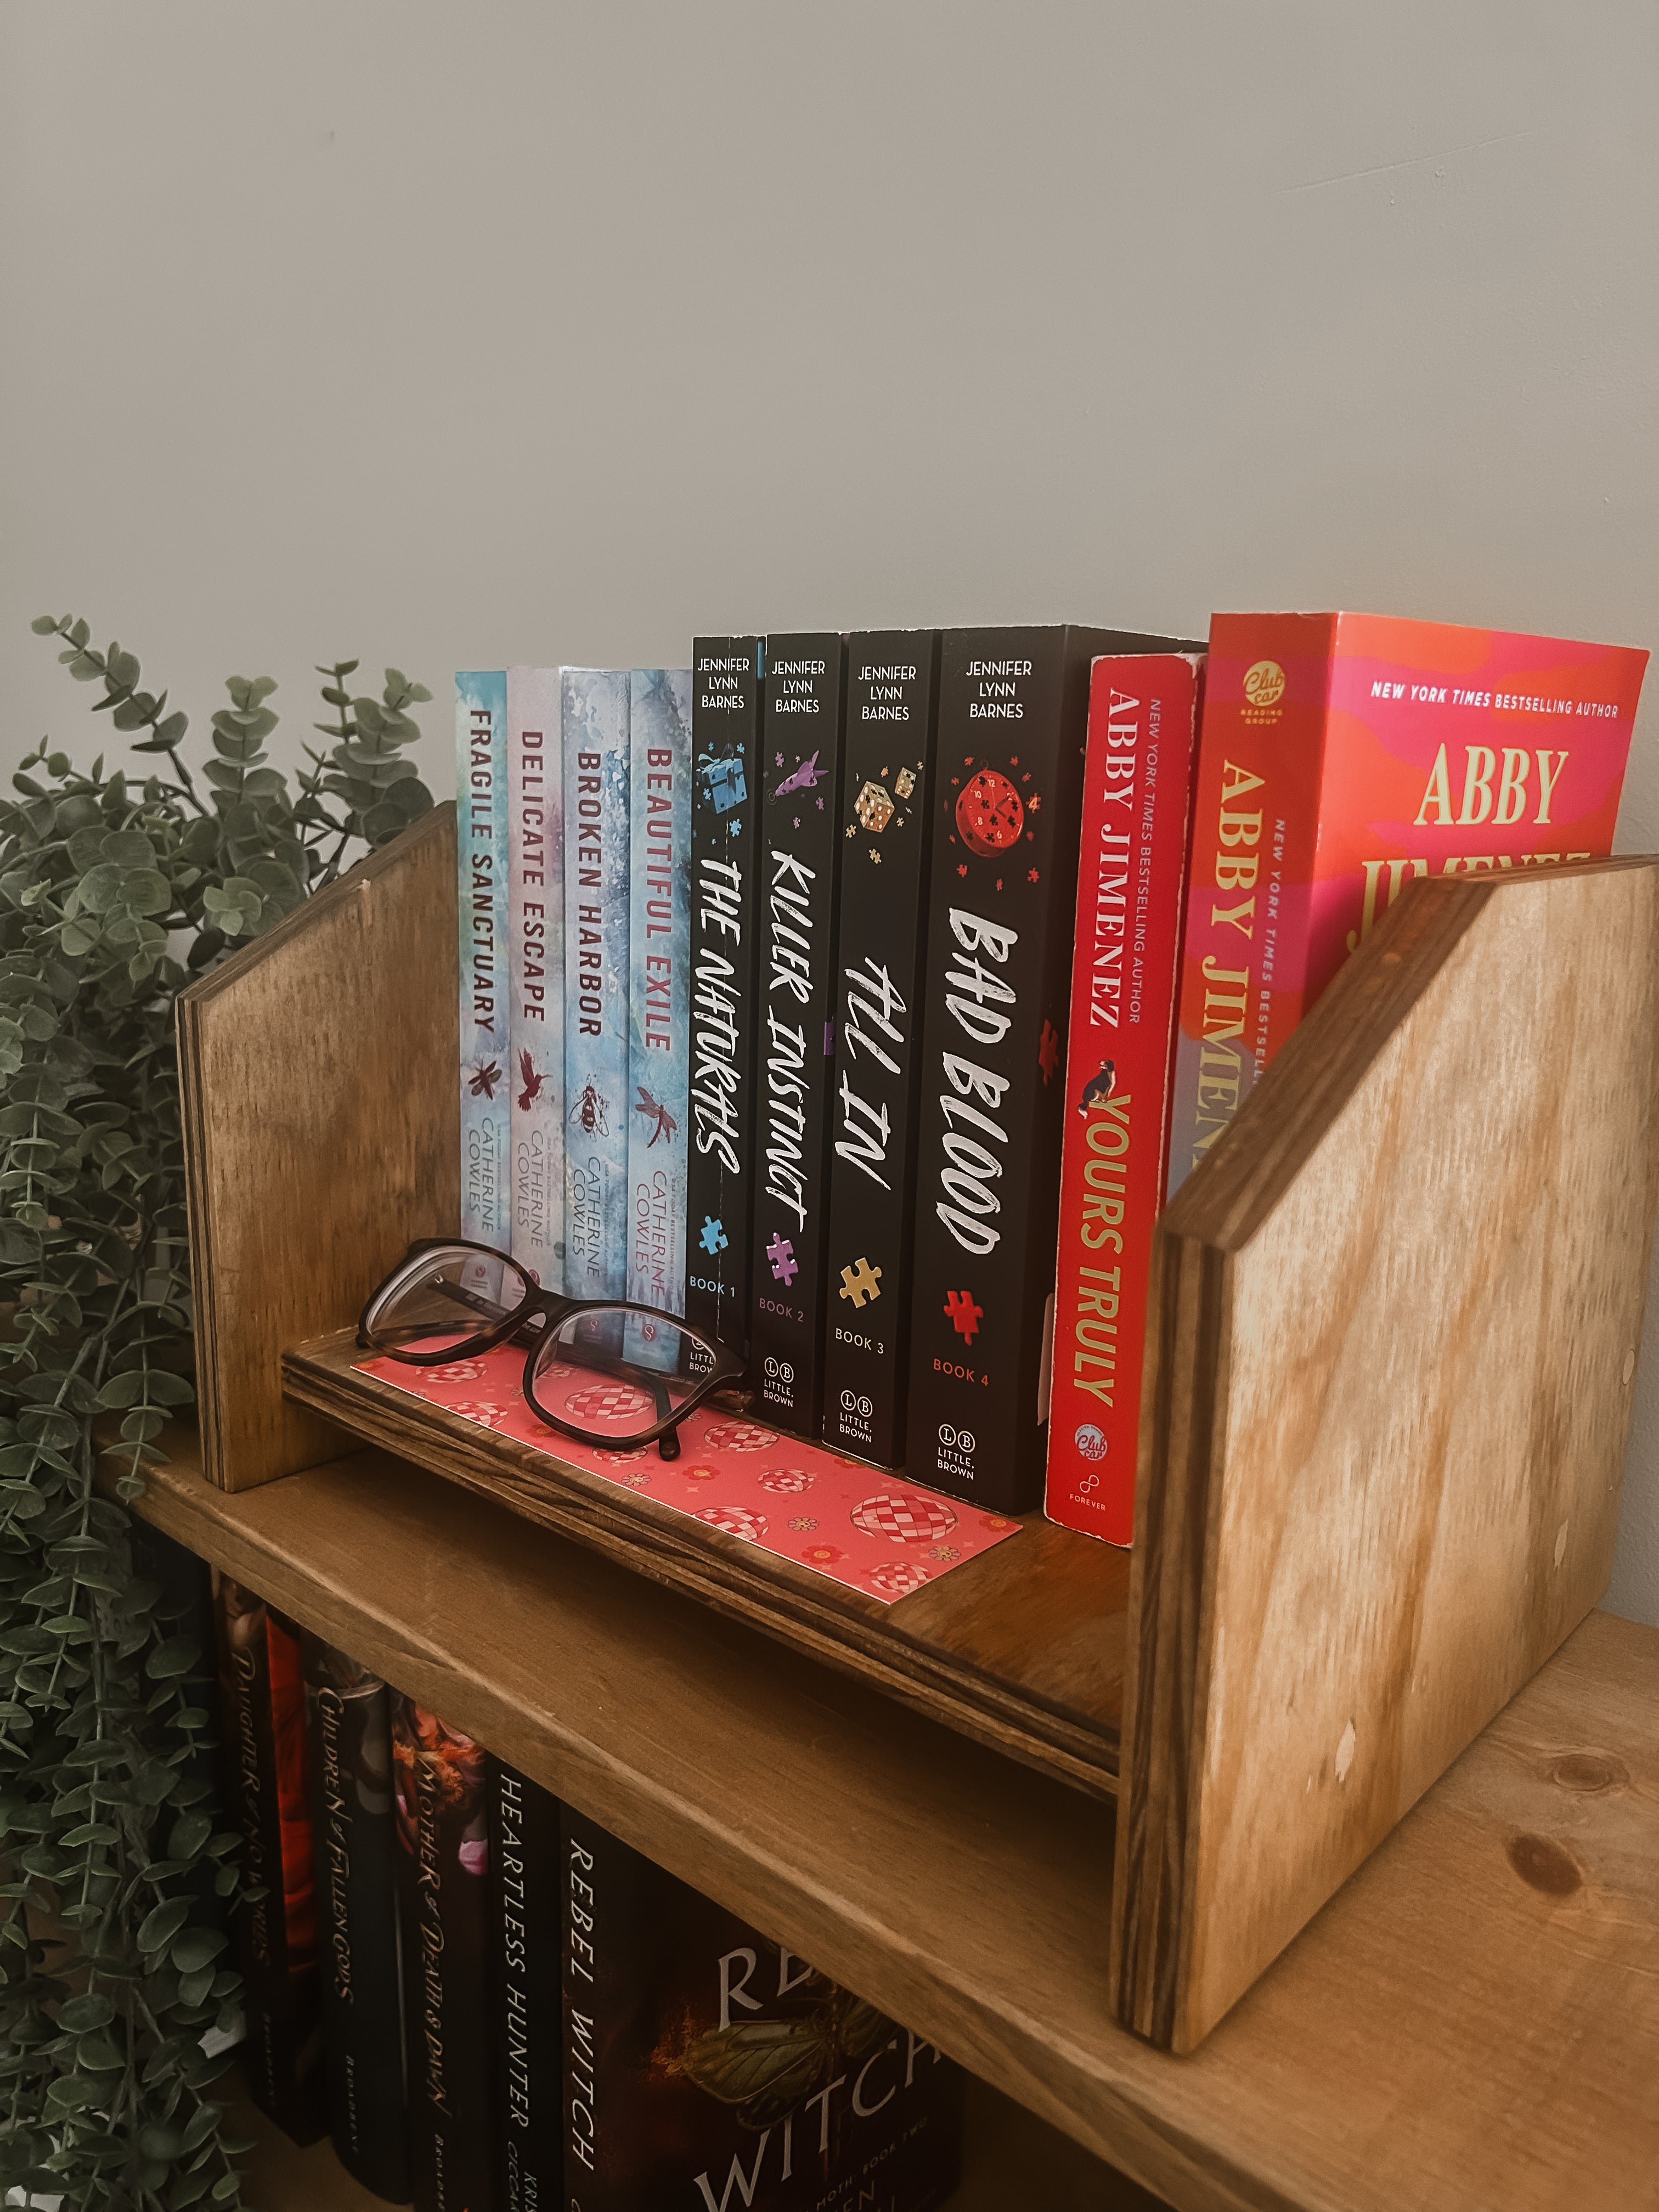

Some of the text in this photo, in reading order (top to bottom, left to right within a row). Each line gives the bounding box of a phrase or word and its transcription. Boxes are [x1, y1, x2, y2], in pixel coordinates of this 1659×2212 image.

[697, 658, 749, 672] JENNIFER
[702, 696, 744, 709] BARNES
[709, 676, 738, 690] LYNN
[772, 661, 825, 675] JENNIFER
[776, 699, 820, 713] BARNES
[783, 680, 812, 694] LYNN
[858, 666, 916, 681] JENNIFER
[870, 686, 902, 701] LYNN
[966, 661, 1032, 676] JENNIFER
[979, 682, 1015, 697] LYNN
[1245, 668, 1283, 695] Club
[1370, 680, 1618, 720] NEW YORK TIMES BESTSELLING AUTHOR
[861, 706, 909, 721] BARNES
[969, 704, 1023, 719] BARNES
[1413, 742, 1570, 827] ABBY
[470, 710, 494, 1033] FRAGILE SANCTUARY
[522, 731, 545, 1022] DELICATE ESCAPE
[578, 752, 602, 1036] BROKEN HARBOR
[645, 748, 673, 1052] BEAUTIFUL EXILE
[1090, 687, 1139, 1029] ABBY JIMENEZ
[1128, 698, 1161, 1024] NEW YORK TIMES BESTSELLING AUTHOR
[1188, 759, 1266, 1172] ABBY JIMEN
[1252, 819, 1286, 1085] NEW YORK TIMES BESTSELL
[690, 859, 742, 1174] THE NATURALS
[764, 850, 816, 1233] KILLER INSTINCT
[834, 957, 907, 1190] ALL IN
[936, 907, 1018, 1254] BAD BLOOD
[469, 1129, 480, 1212] COWLES
[482, 1116, 494, 1232] CATHERINE
[518, 1142, 529, 1228] COWLES
[532, 1130, 544, 1249] CATHERINE
[573, 1169, 585, 1256] COWLES
[587, 1156, 601, 1279] CATHERINE
[635, 1183, 650, 1274] COWLES
[651, 1170, 667, 1296] CATHERINE
[1073, 1094, 1131, 1408] YOURS TRULY
[690, 1276, 736, 1297] BOOK 1
[759, 1297, 804, 1323] BOOK 2
[690, 1352, 714, 1364] LITTL
[836, 1328, 884, 1354] BOOK 3
[933, 1358, 989, 1387] BOOK 4
[763, 1390, 793, 1408] BROWN
[839, 1424, 872, 1443] BROWN
[937, 1462, 974, 1481] BROWN
[1077, 1434, 1106, 1452] Club
[1069, 1493, 1106, 1511] FOREVER
[231, 1647, 261, 1793] DAUGHTER
[318, 1686, 352, 1824] CHILDREN
[416, 1757, 441, 1889] MOTHER
[326, 1837, 350, 1935] FALLEN
[568, 1838, 595, 1982] REBEL
[332, 1931, 354, 2004] GODS
[419, 1921, 444, 2008] DEATH
[500, 1773, 529, 2128] HEARTLESS HUNTER
[424, 2029, 453, 2118] DAWN
[571, 2008, 595, 2171] WITCH
[863, 2141, 896, 2175] BOOK
